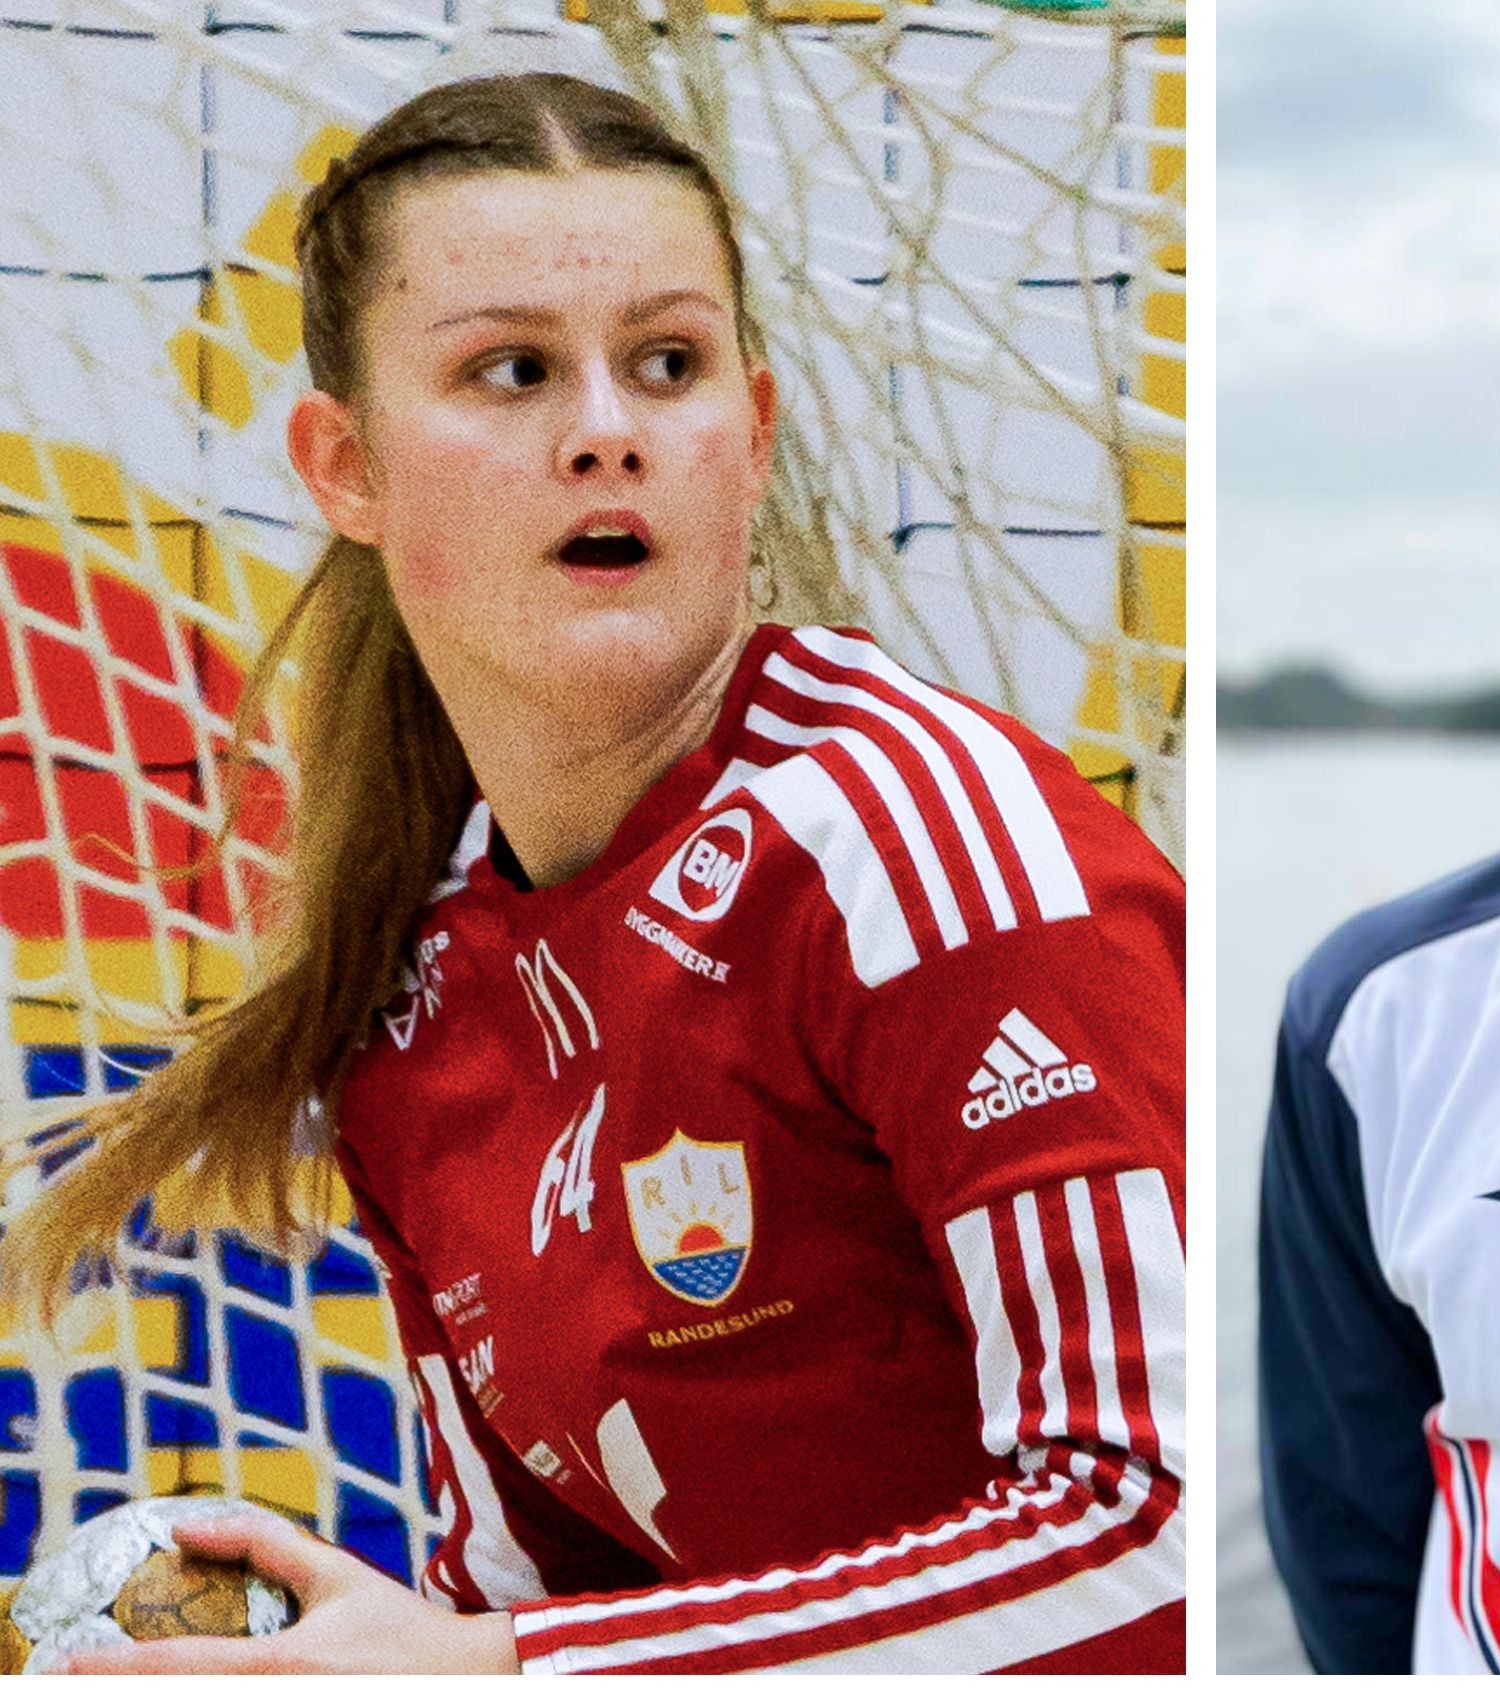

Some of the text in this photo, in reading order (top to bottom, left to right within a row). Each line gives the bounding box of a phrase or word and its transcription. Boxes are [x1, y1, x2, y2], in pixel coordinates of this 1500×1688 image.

[683, 838, 743, 897] BM
[961, 1062, 1097, 1130] adidas
[531, 1082, 605, 1258] 64
[648, 1300, 794, 1348] RANDESUND
